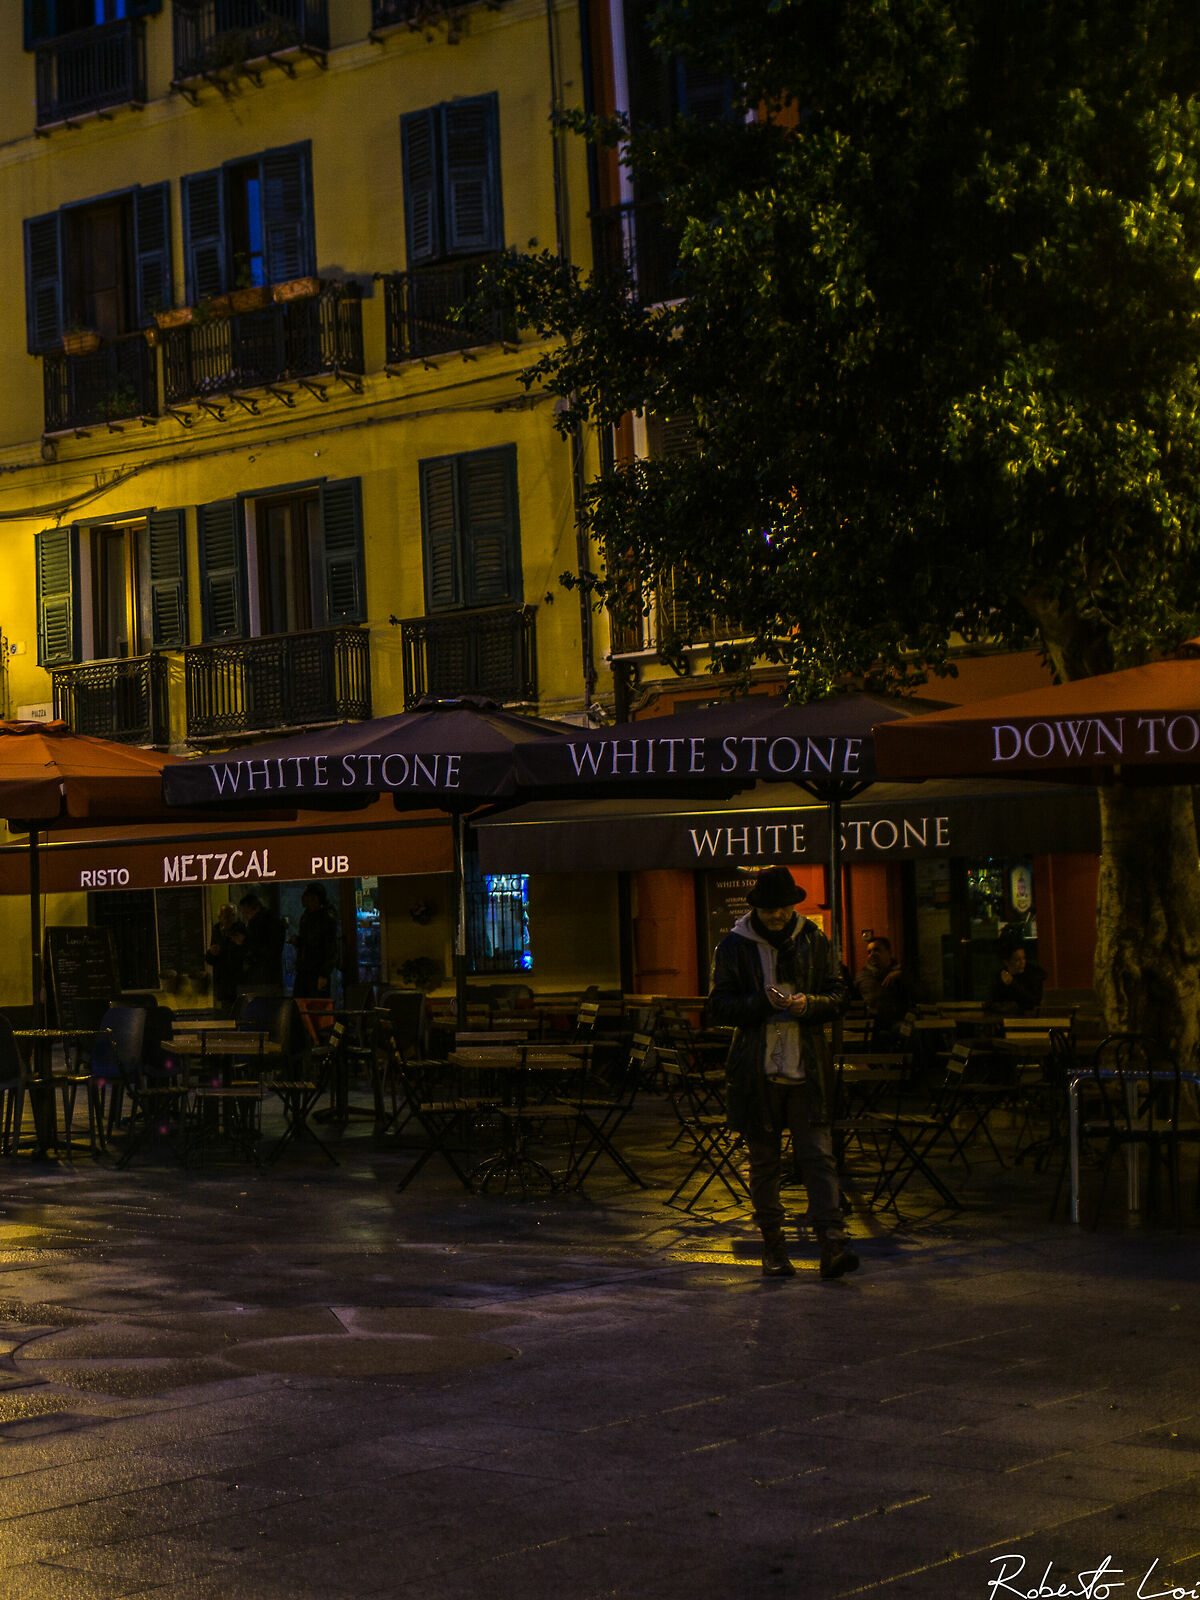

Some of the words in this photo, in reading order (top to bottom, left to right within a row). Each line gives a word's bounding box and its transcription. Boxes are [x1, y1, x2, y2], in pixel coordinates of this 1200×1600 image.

[566, 737, 705, 777] WHITE
[720, 735, 862, 774] STONE
[991, 717, 1125, 761] DOWN
[1137, 714, 1200, 755] TO
[209, 755, 330, 796] WHITE
[341, 753, 463, 789] STONE
[689, 824, 806, 858] WHITE
[80, 867, 131, 887] RISTO
[163, 848, 277, 884] METZCAL
[311, 855, 350, 876] PUB
